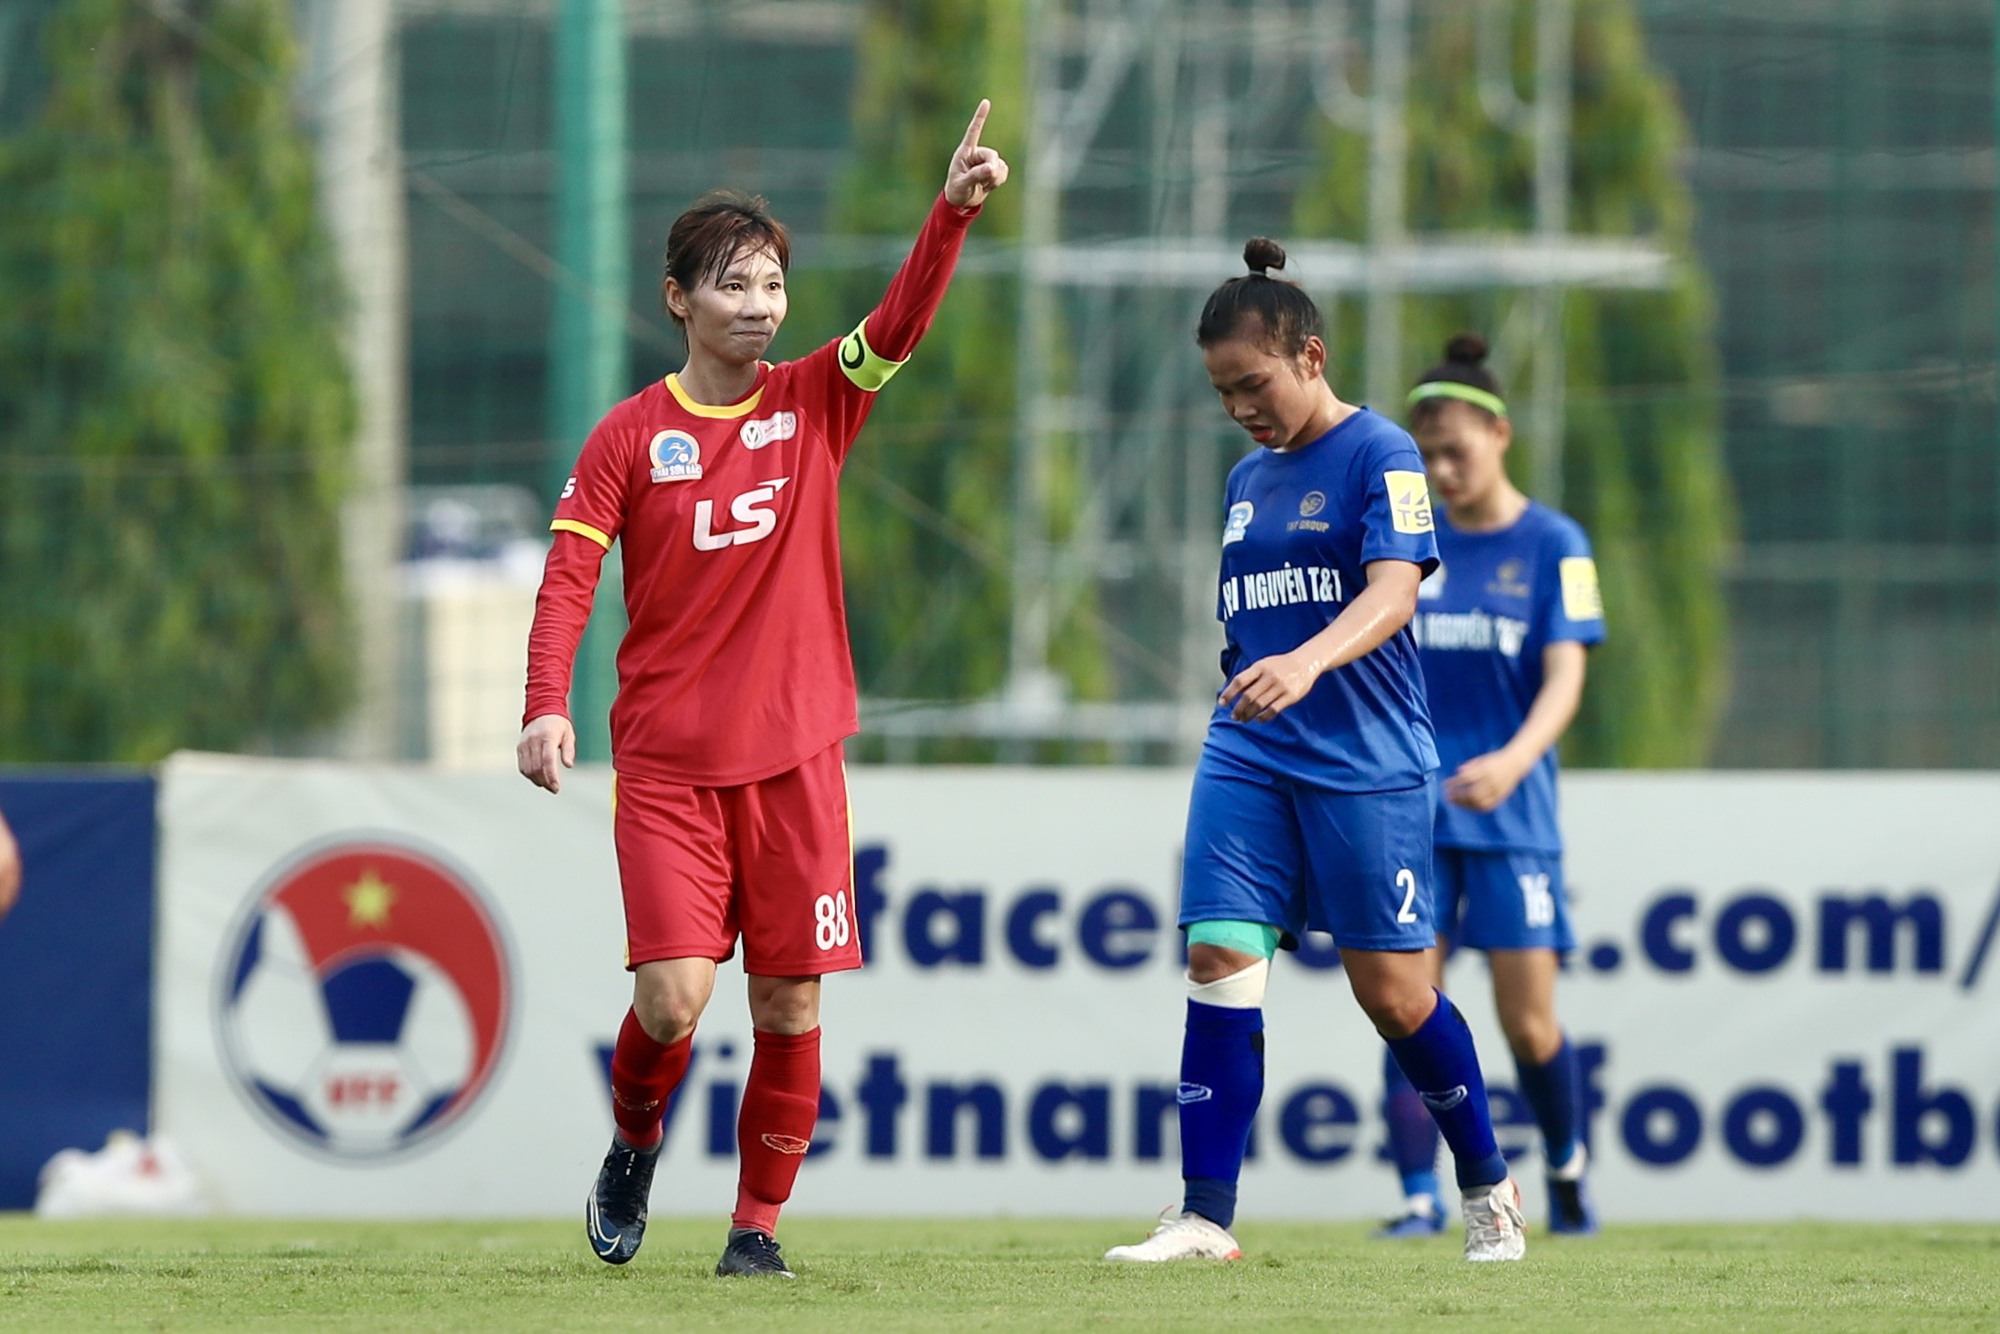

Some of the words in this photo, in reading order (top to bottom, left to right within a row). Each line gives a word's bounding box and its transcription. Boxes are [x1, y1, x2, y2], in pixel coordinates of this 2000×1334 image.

[692, 477, 790, 551] LS
[1243, 561, 1308, 610] NGUYÊN
[815, 889, 849, 951] 88
[1396, 868, 1417, 924] 2
